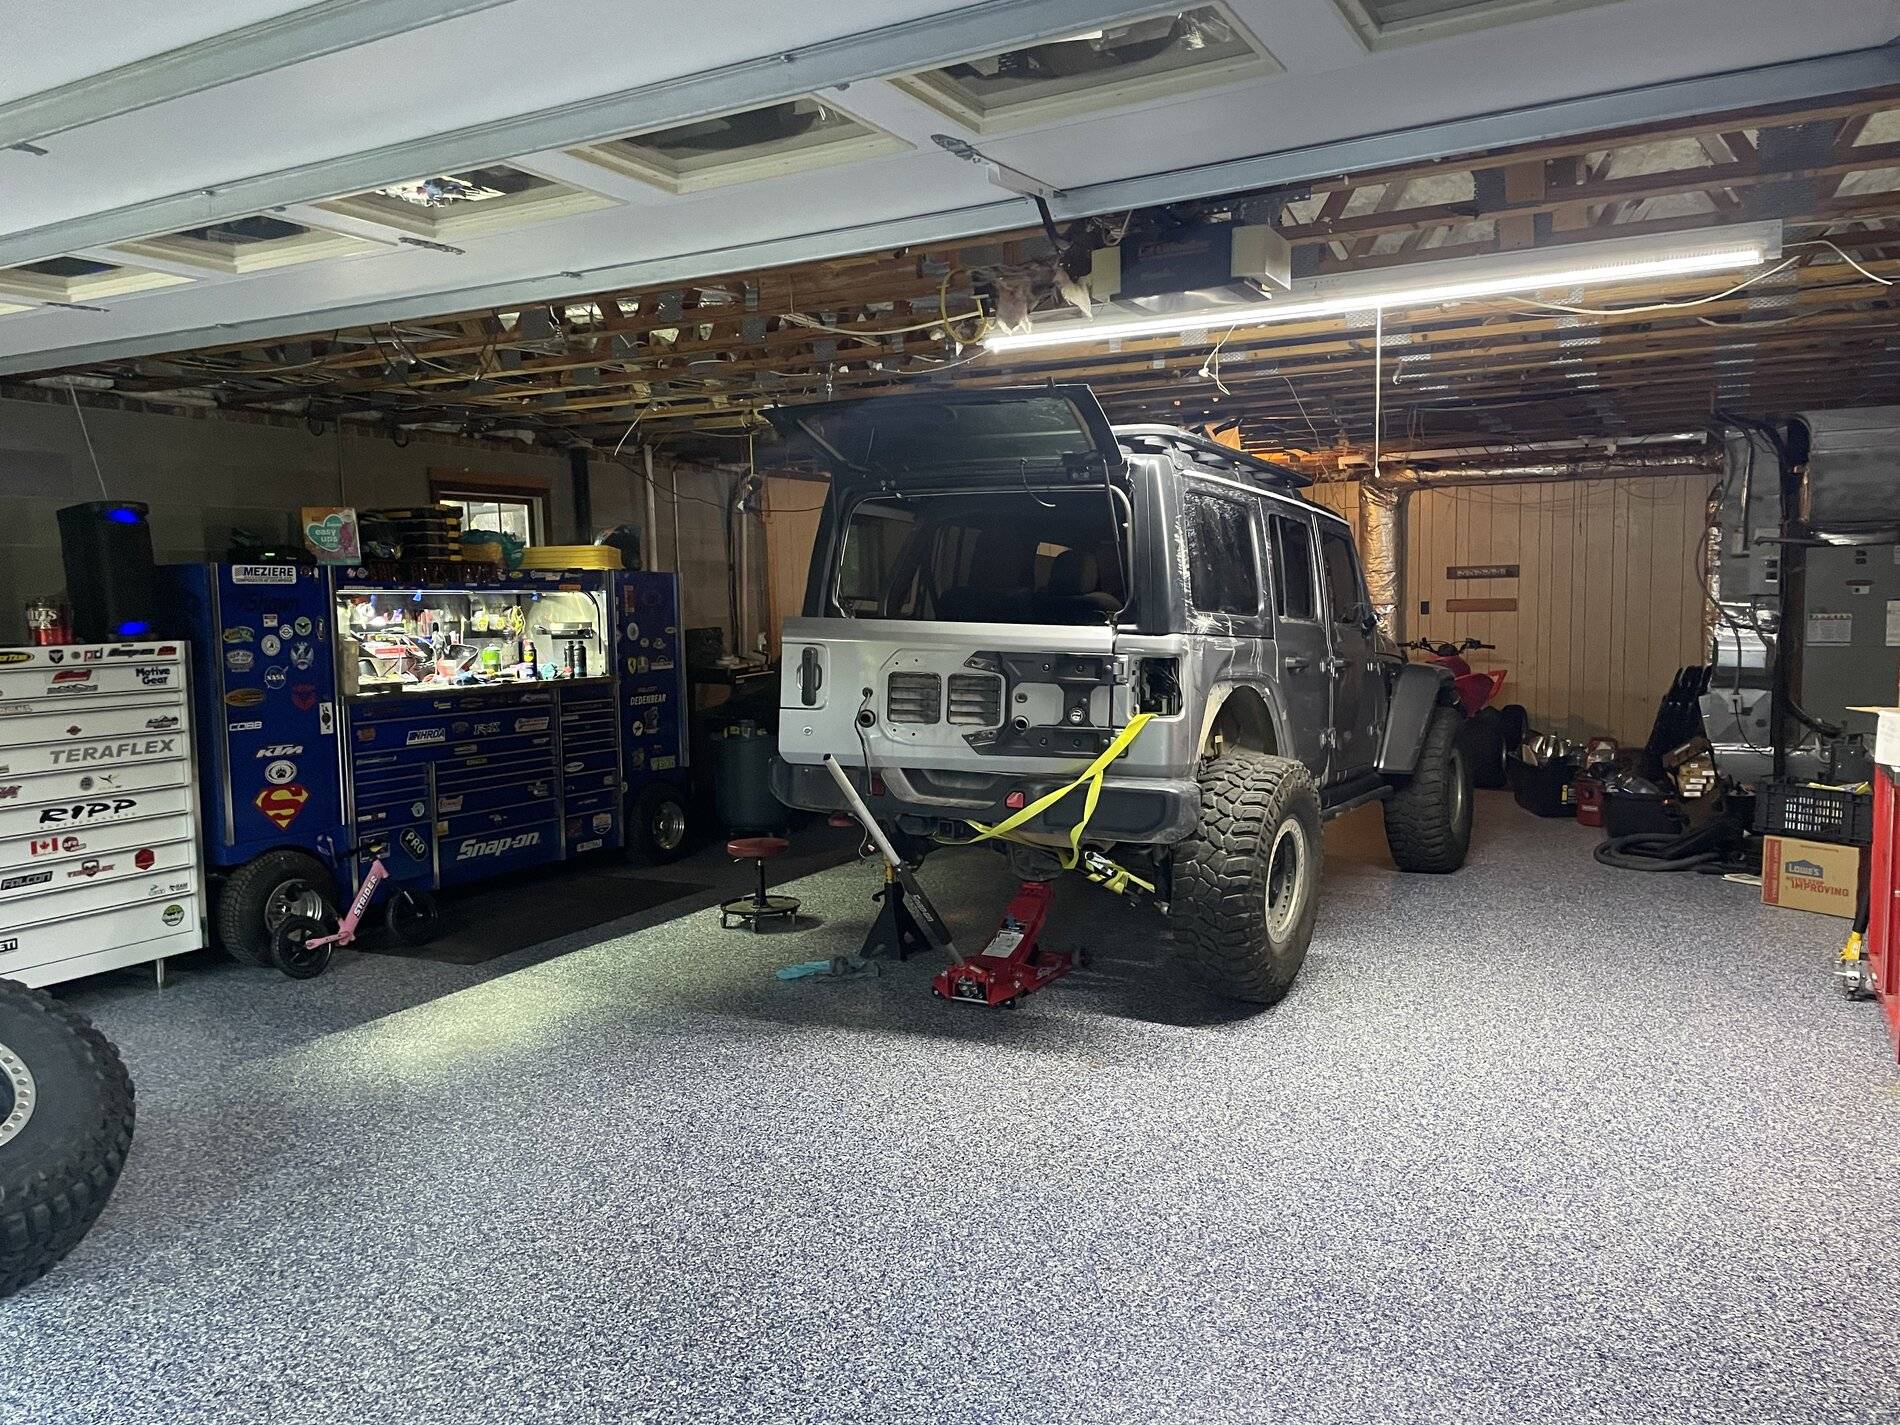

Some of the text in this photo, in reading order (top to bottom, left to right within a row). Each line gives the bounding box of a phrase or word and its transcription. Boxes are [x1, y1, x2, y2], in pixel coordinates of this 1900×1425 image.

[243, 567, 294, 577] MEZIERE
[136, 668, 171, 678] Motive
[142, 676, 168, 686] Gear
[50, 738, 175, 766] TERAFLEX
[256, 744, 304, 758] KTM
[39, 799, 137, 824] RIPP
[405, 832, 425, 854] PRO
[456, 832, 540, 861] Snap-on
[3, 873, 51, 889] FALCON
[1791, 880, 1849, 897] IMPROVING
[354, 875, 378, 917] STRIDER
[0, 940, 16, 951] ETI
